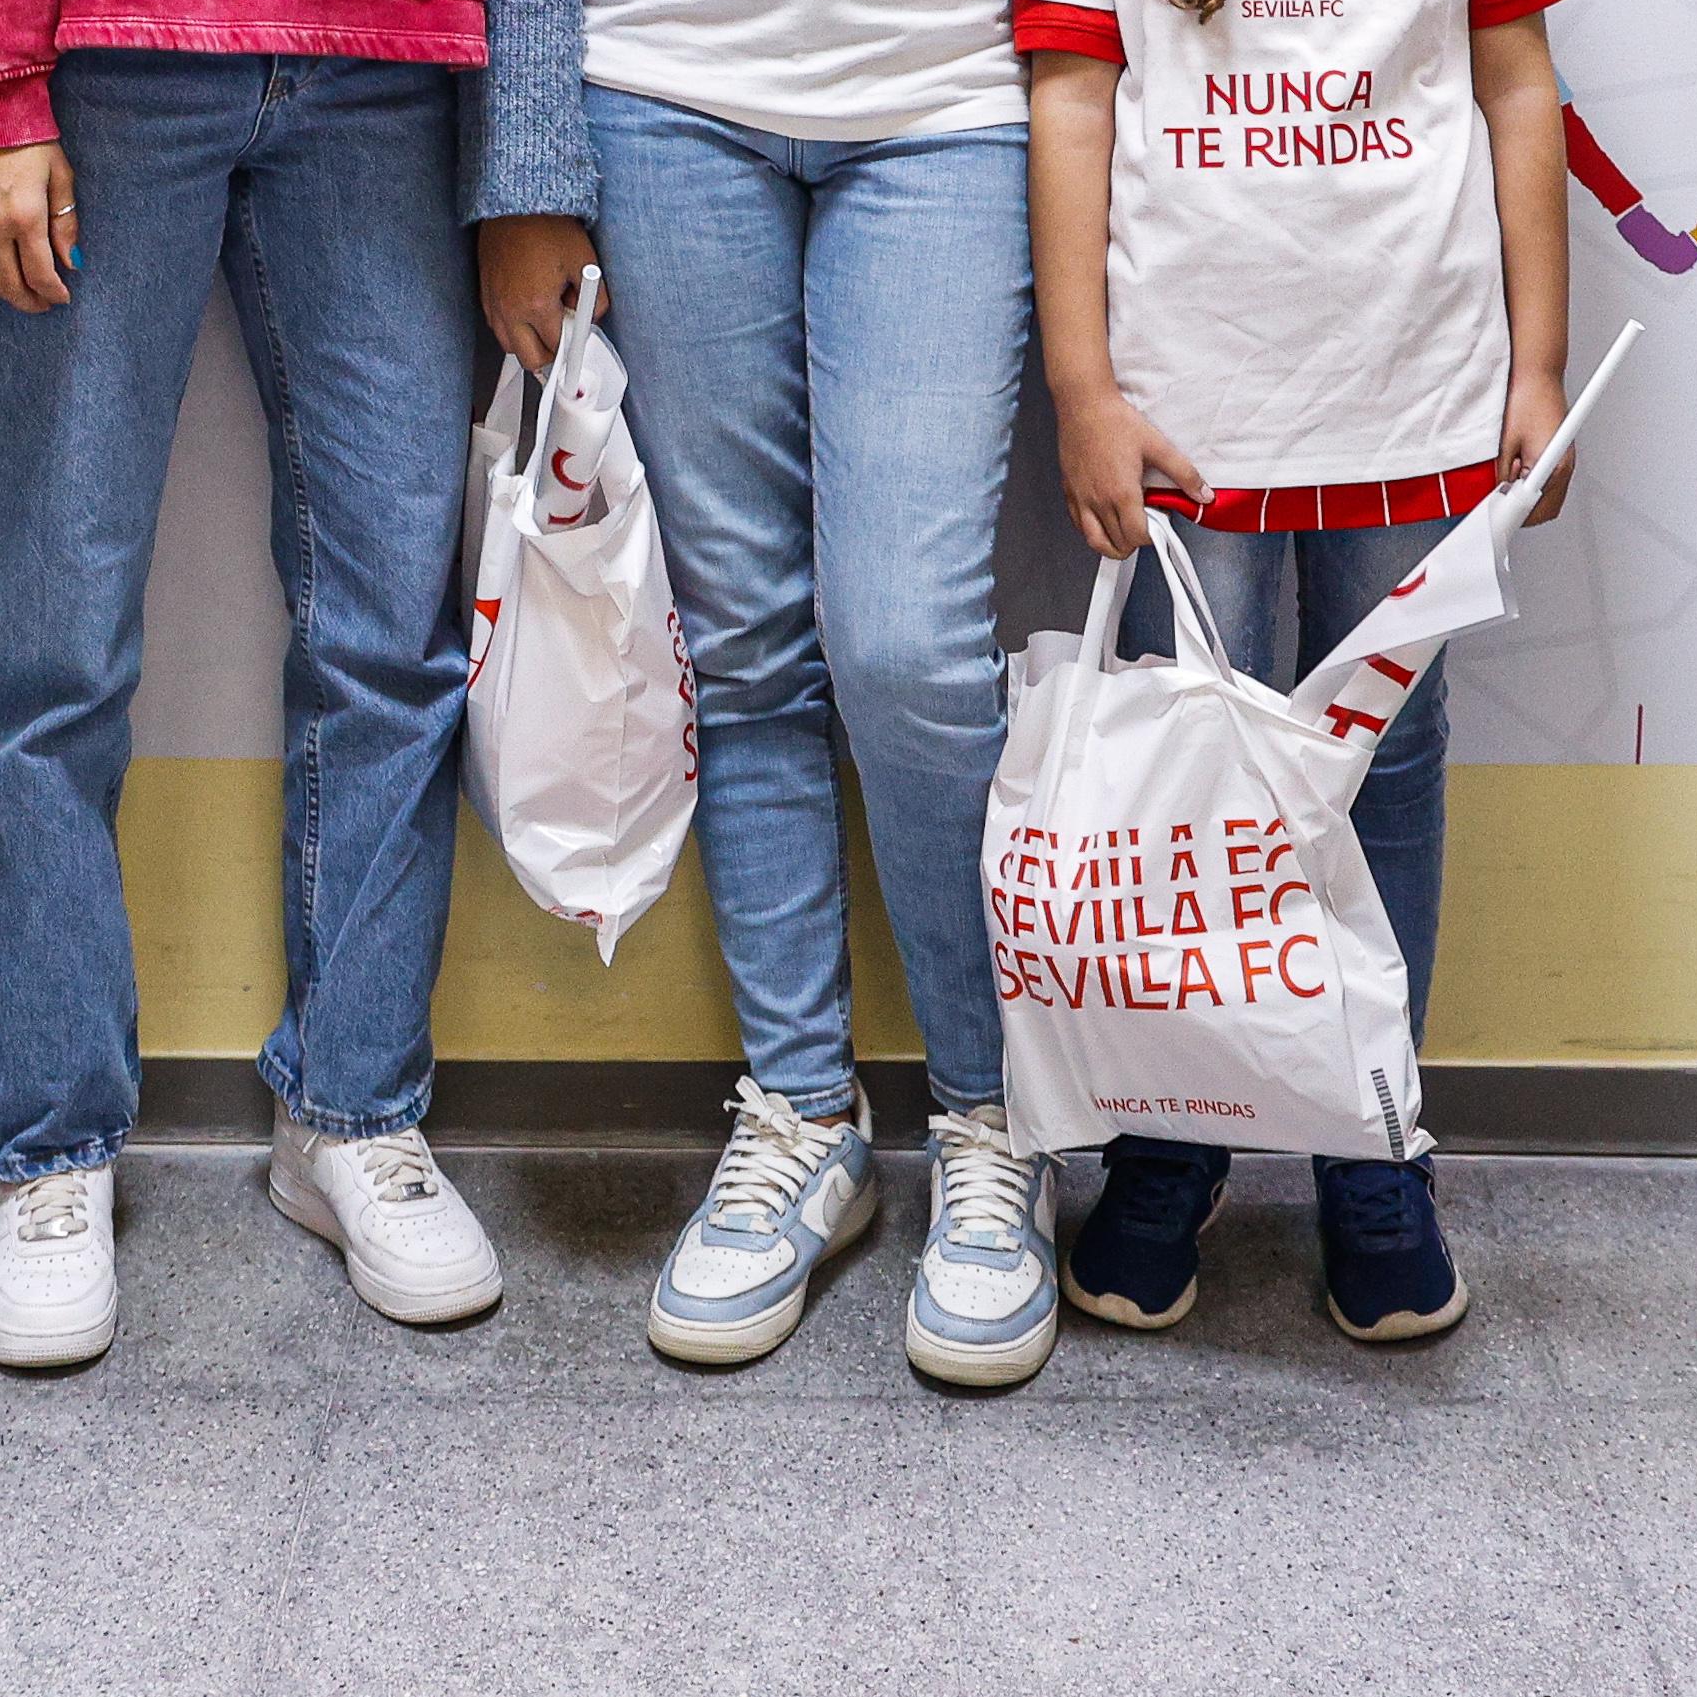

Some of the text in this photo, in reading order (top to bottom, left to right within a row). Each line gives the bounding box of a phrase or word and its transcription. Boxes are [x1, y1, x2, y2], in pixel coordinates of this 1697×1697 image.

[1241, 0, 1344, 18] SEVILLA FC
[1205, 70, 1373, 115] NUNCA
[1163, 118, 1413, 169] TE RINDAS
[994, 934, 1326, 1010] SEVILLA FC
[1155, 1098, 1181, 1113] TE
[1185, 1099, 1256, 1119] RINDAS
